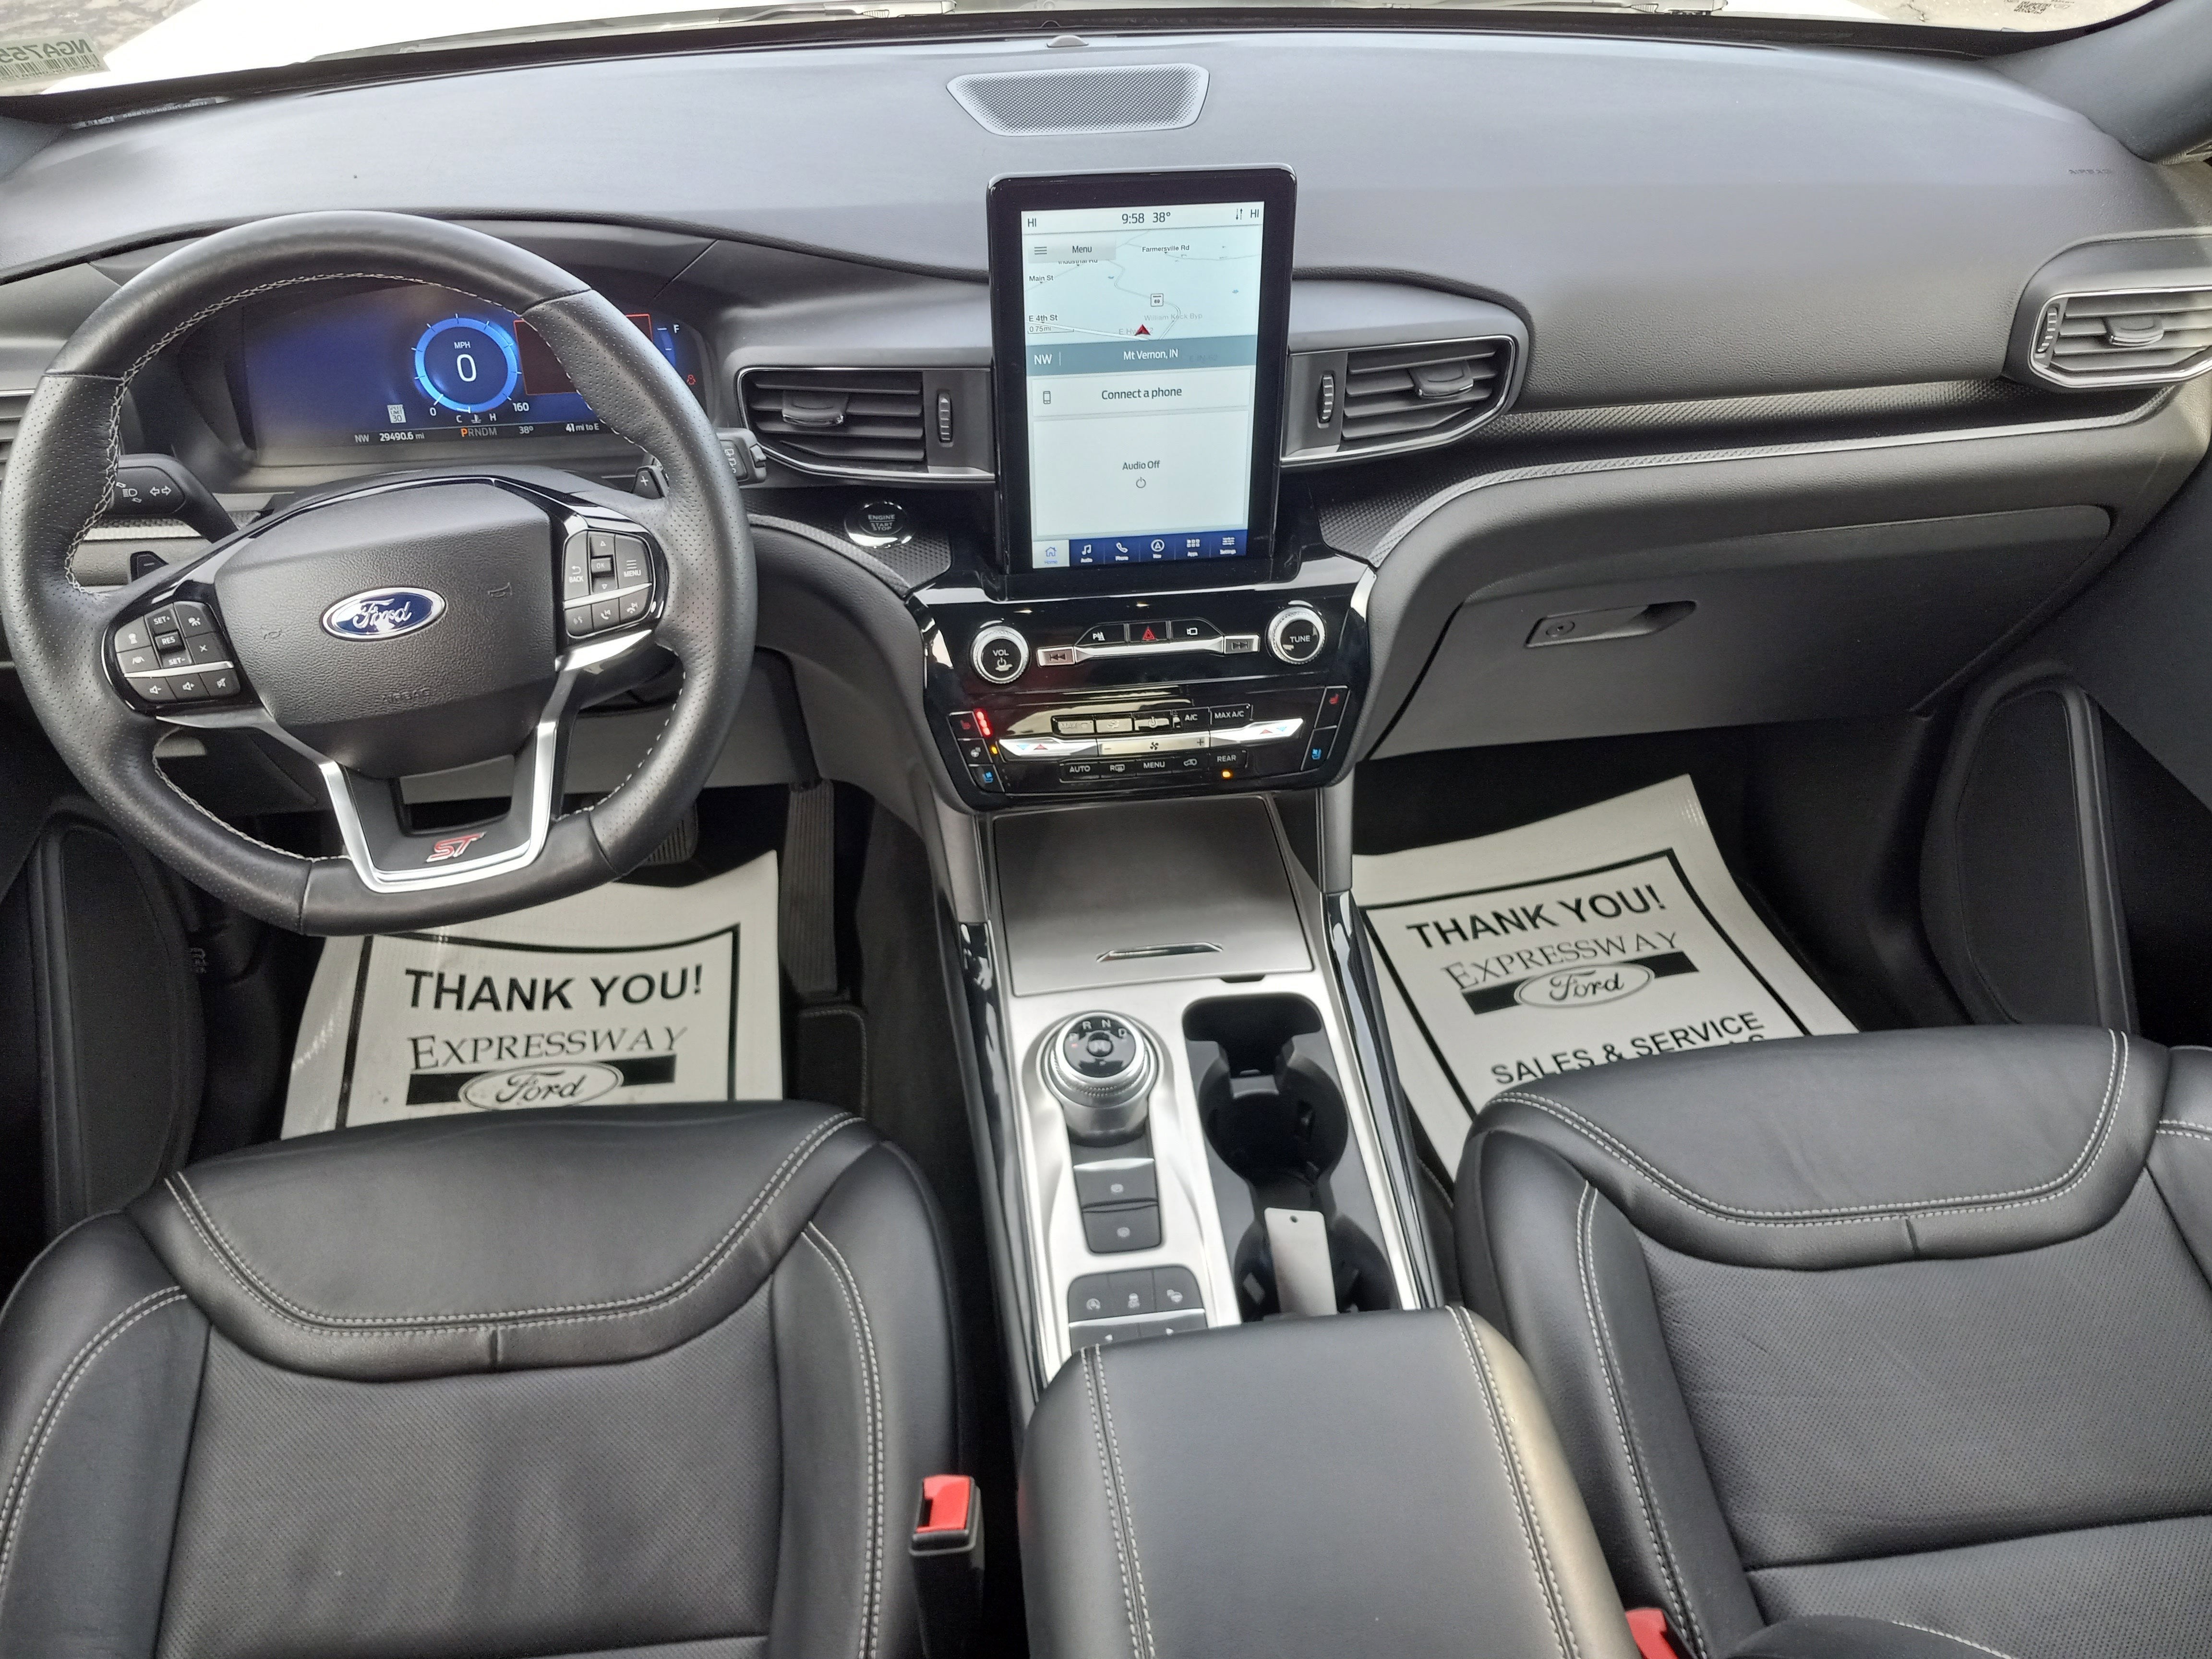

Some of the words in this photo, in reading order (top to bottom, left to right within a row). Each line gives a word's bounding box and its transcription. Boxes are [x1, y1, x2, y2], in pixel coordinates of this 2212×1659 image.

[1122, 213, 1145, 224] 9:58
[1153, 212, 1171, 223] 38°
[1250, 209, 1259, 218] HI
[1027, 218, 1037, 228] HI
[1072, 245, 1093, 253] Menu
[673, 325, 680, 333] F
[454, 341, 471, 349] MPH
[1034, 354, 1053, 365] NW
[1123, 351, 1135, 361] Mt
[1137, 350, 1168, 360] Vernon,
[1169, 349, 1179, 358] IN
[457, 354, 477, 382] 0
[1101, 388, 1142, 400] Connect
[1152, 387, 1183, 400] phone
[430, 407, 437, 416] 0
[512, 402, 529, 412] 160
[456, 415, 463, 423] C
[489, 413, 497, 421] H
[565, 423, 575, 433] 41
[576, 423, 585, 431] mi
[354, 434, 370, 443] NW
[379, 432, 414, 442] 29490.6
[1122, 461, 1146, 470] Audio
[1147, 460, 1160, 469] Off
[624, 569, 641, 577] MENU
[353, 598, 412, 629] Ford
[161, 636, 176, 645] RES
[1289, 635, 1310, 643] TUNE
[1217, 754, 1237, 762] REAR
[1069, 765, 1091, 773] AUTO
[425, 832, 487, 863] ST
[1406, 902, 1561, 949] THANK
[1557, 884, 1667, 925] YOU!
[1441, 930, 1678, 990] EXPRESSWAY
[405, 967, 577, 1012] THANK
[589, 963, 703, 1008] YOU!
[1548, 970, 1624, 1001] Ford
[1082, 1021, 1093, 1030] R
[1101, 1019, 1111, 1028] N
[1118, 1027, 1128, 1037] D
[1630, 1011, 1766, 1057] SERVICE
[407, 1025, 688, 1071] EXPRESSWAY
[495, 1070, 587, 1102] Ford
